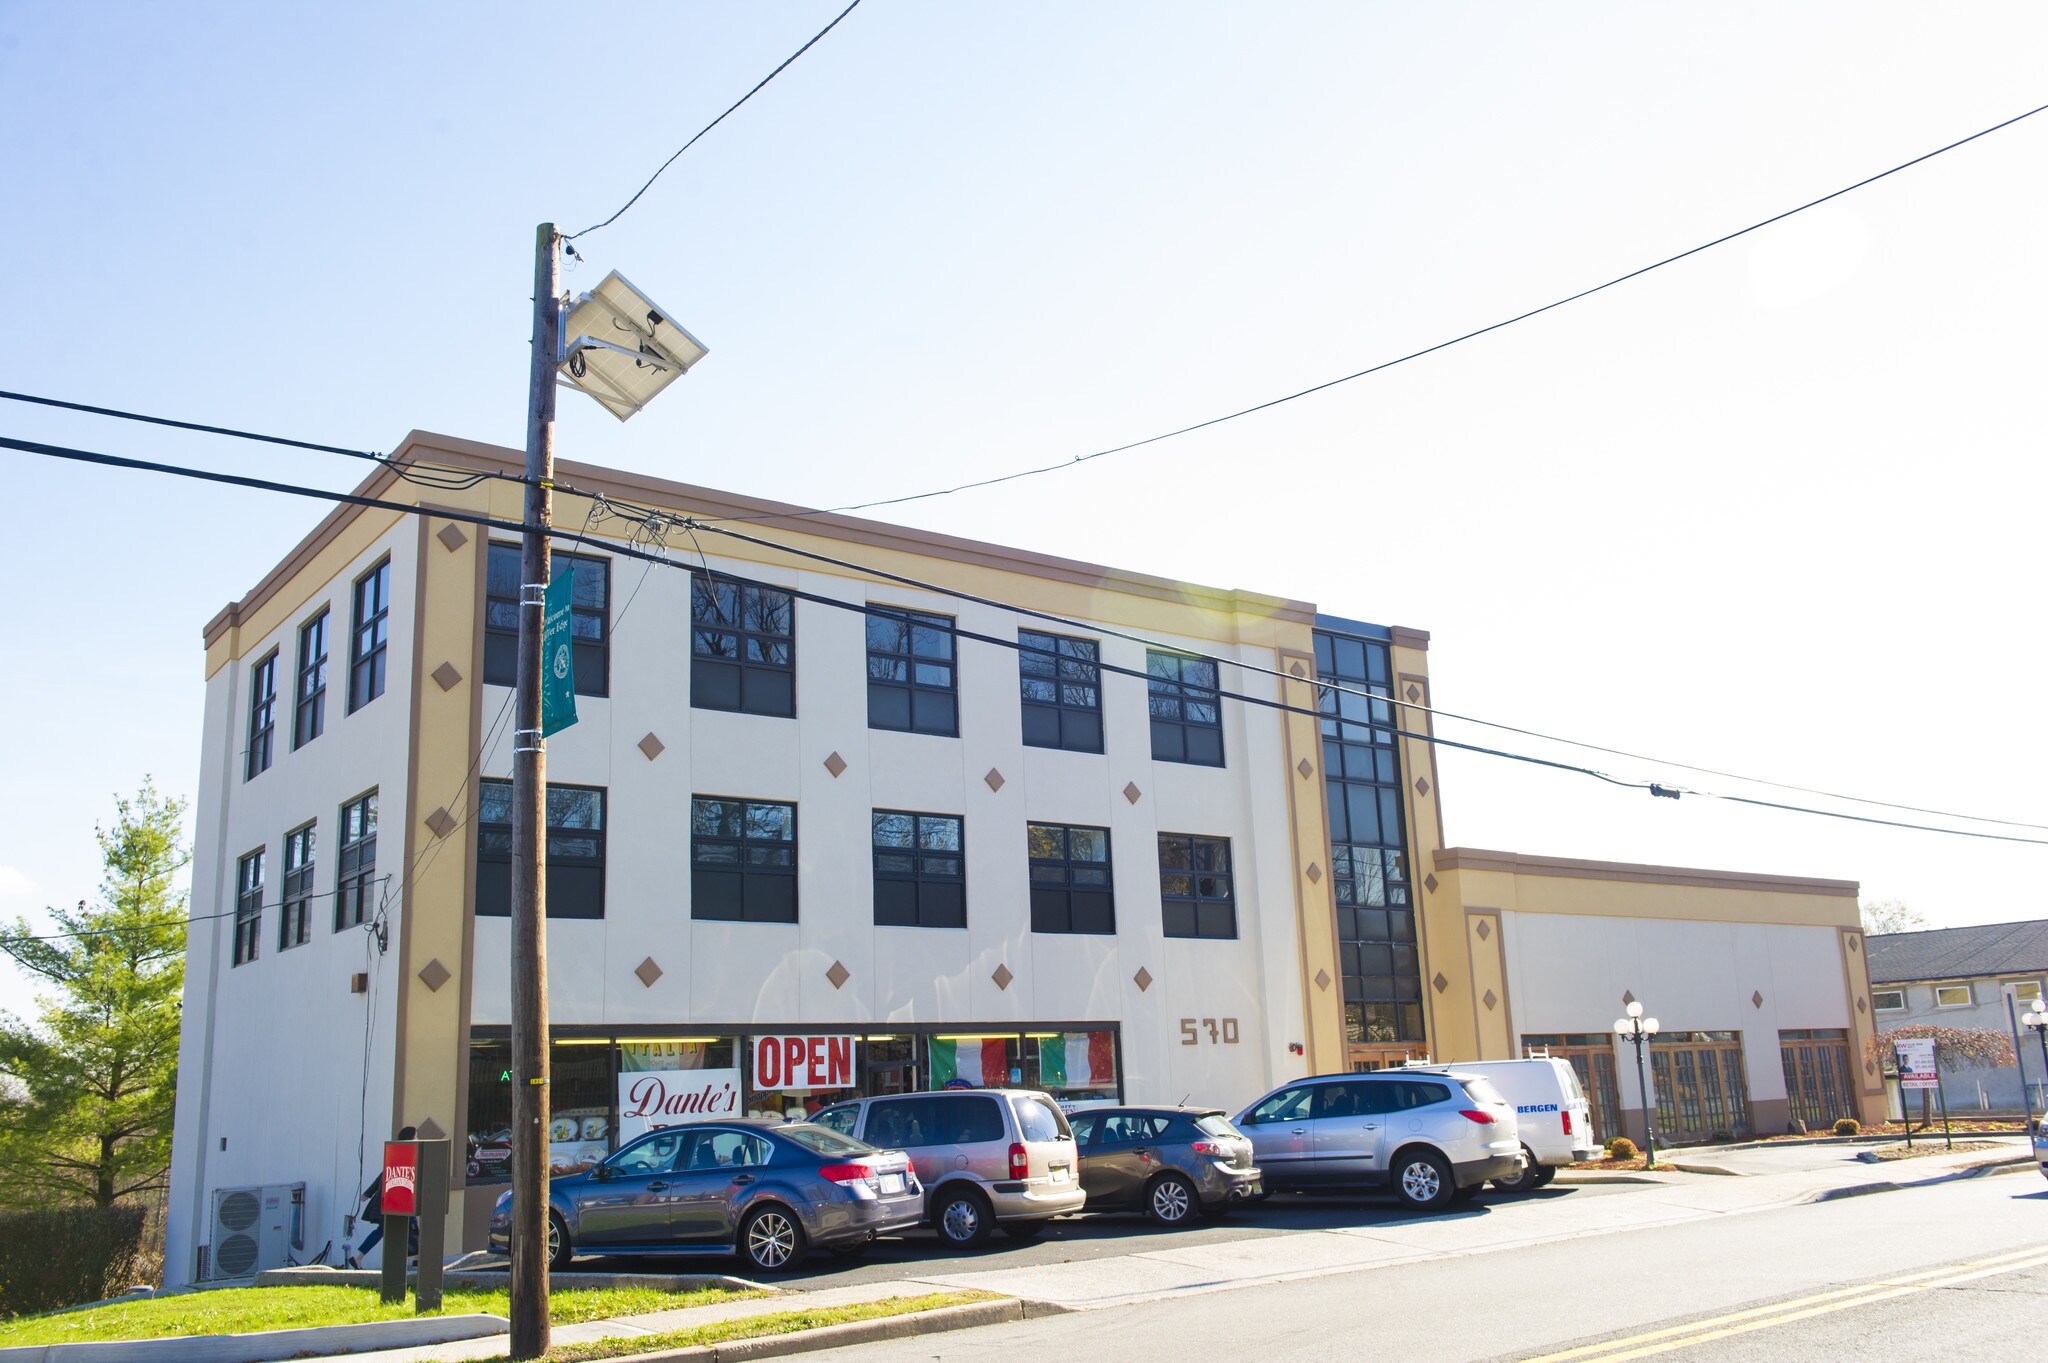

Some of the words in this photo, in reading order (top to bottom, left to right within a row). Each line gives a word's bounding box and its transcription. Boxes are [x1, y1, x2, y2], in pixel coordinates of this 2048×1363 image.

[1180, 1018, 1239, 1045] 570
[758, 1036, 850, 1087] OPEN
[624, 1077, 738, 1118] Dante's
[1517, 1104, 1558, 1113] BERGEN
[385, 1166, 415, 1182] DANTE'S
